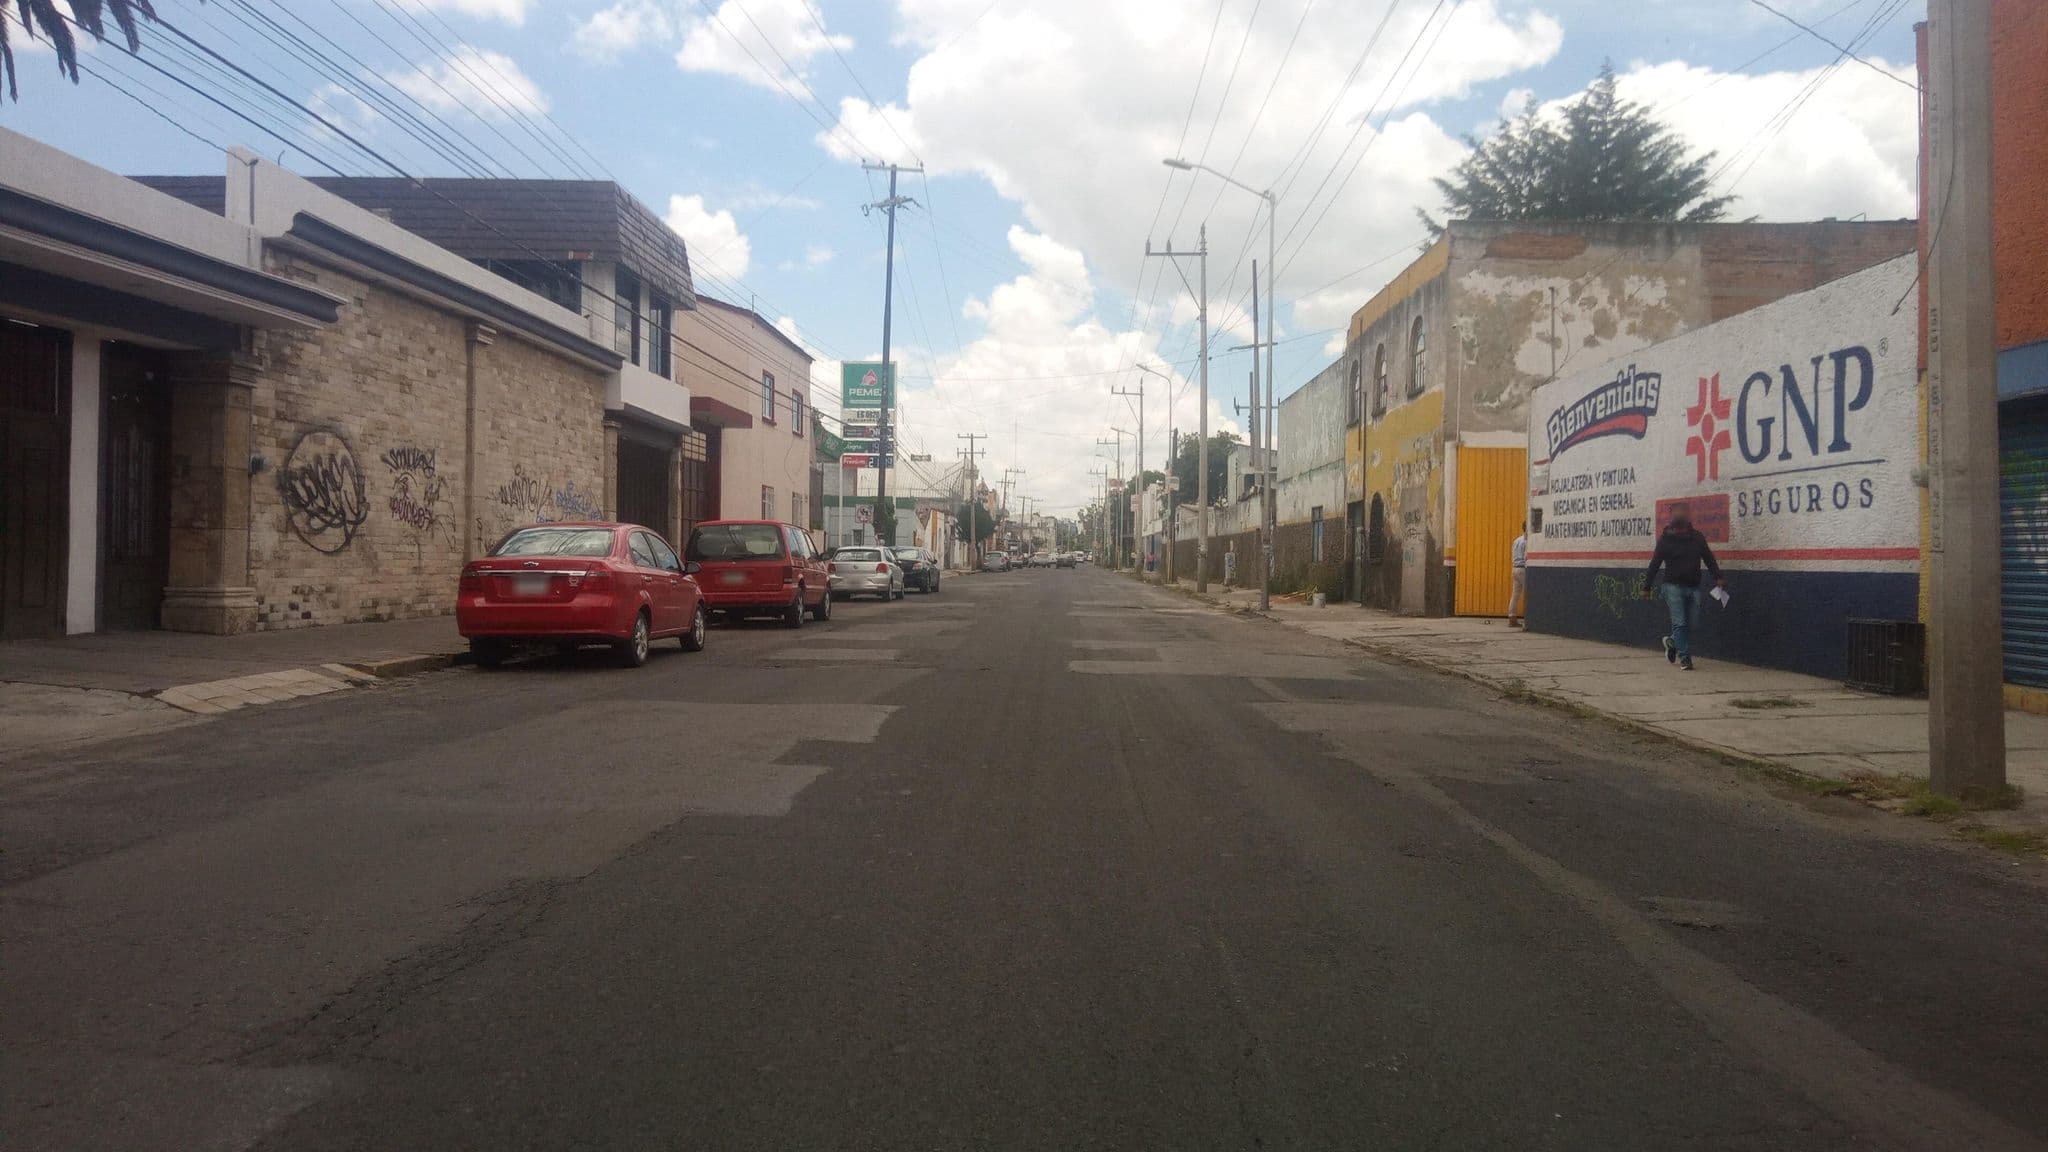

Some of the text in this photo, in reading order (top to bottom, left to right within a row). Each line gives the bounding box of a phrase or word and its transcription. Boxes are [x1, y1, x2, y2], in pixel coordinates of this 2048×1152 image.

[849, 388, 885, 397] PEME
[1547, 364, 1661, 458] Bienvenidos
[1737, 346, 1874, 464] GNP
[1594, 472, 1601, 489] Y
[1602, 467, 1636, 487] PINTURA
[1588, 497, 1598, 513] EN
[1600, 493, 1635, 511] GENERAL
[1738, 478, 1874, 517] SEGUROS
[1545, 517, 1652, 538] MANTENIMIENTO AUTOMOTRIZ
